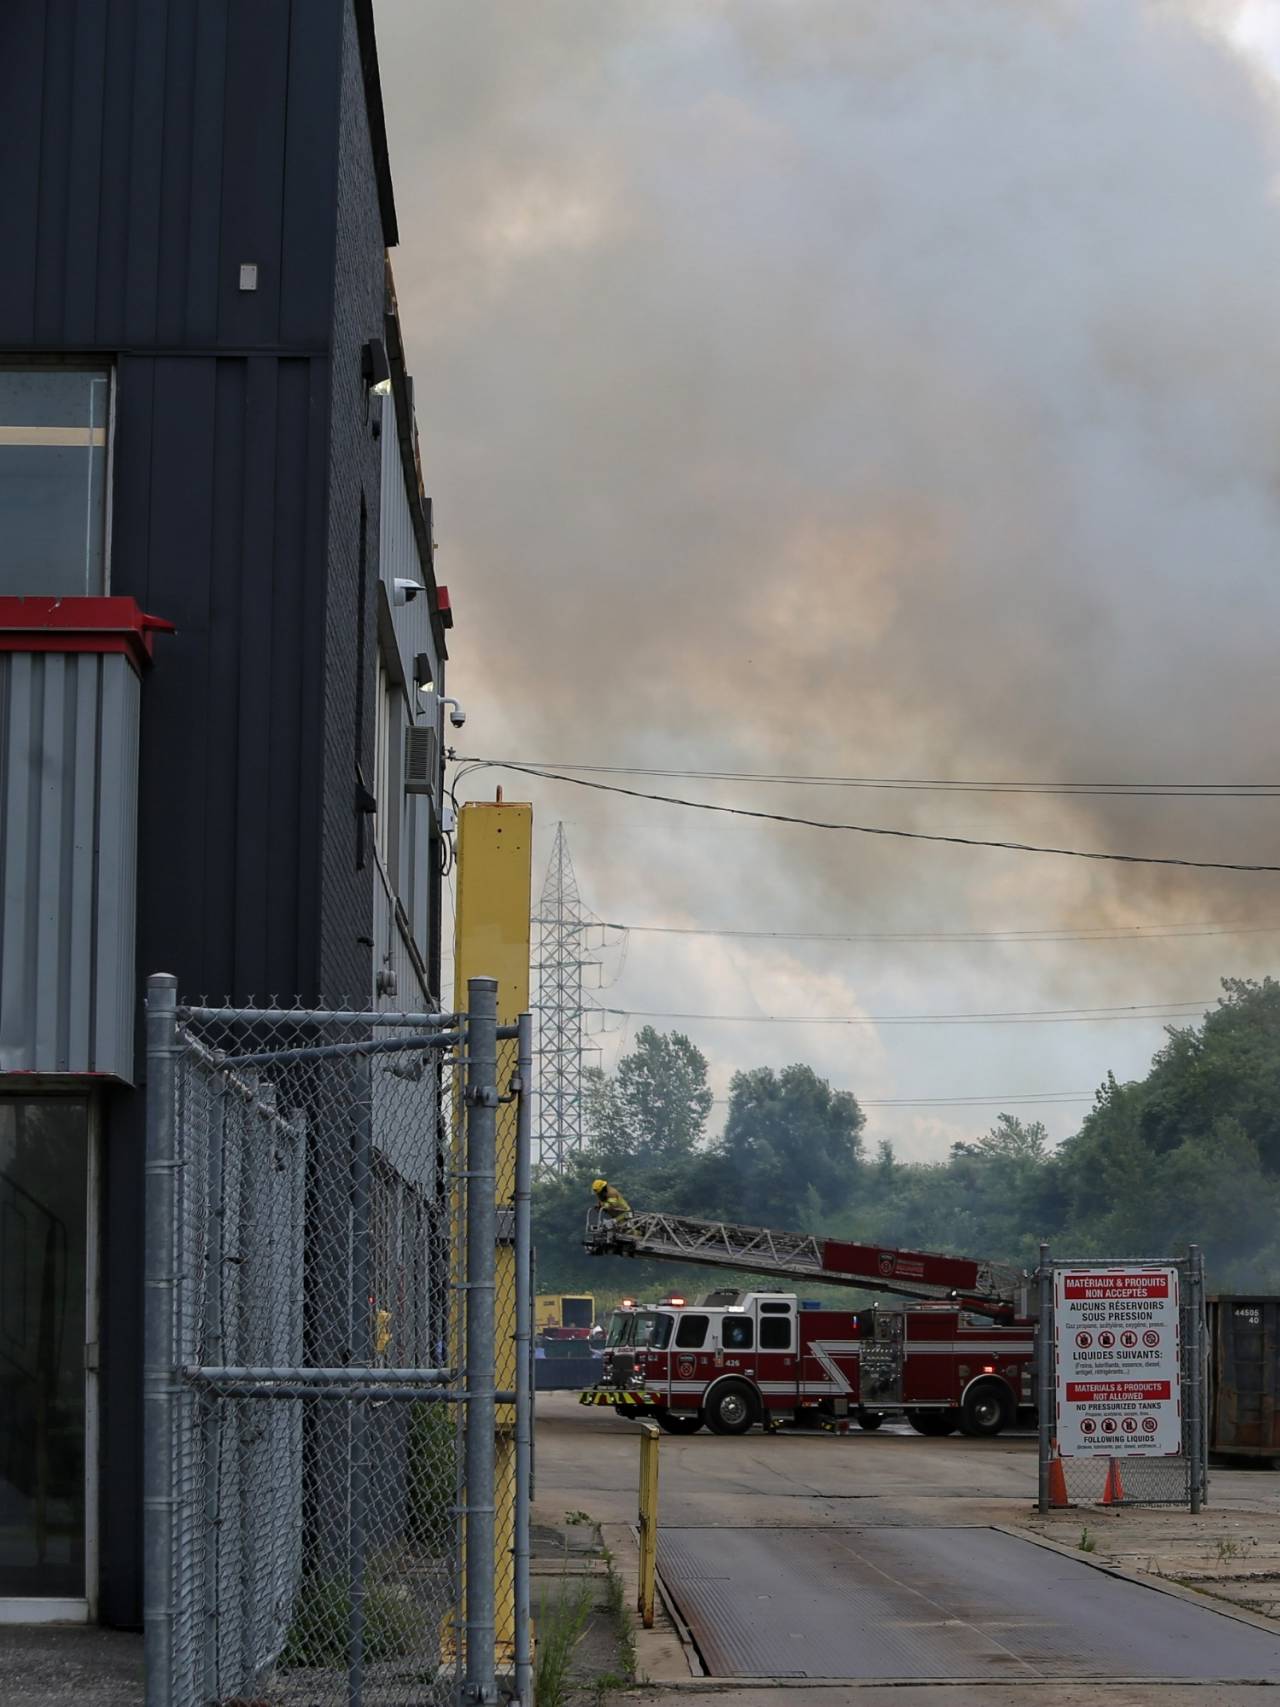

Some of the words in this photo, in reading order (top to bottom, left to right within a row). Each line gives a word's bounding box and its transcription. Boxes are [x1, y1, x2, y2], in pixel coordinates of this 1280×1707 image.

[1066, 1276, 1114, 1288] MATÉRIAUX
[1116, 1278, 1123, 1287] &
[1125, 1278, 1166, 1287] PRODUITS
[1085, 1289, 1104, 1298] NON
[1105, 1287, 1148, 1297] ACCEPTÉS
[1070, 1302, 1106, 1311] AUCUNS
[1108, 1300, 1164, 1311] RÉSERVOIRS
[1082, 1312, 1106, 1321] SOUS
[1108, 1311, 1153, 1321] PRESSION
[1073, 1351, 1114, 1361] LIQUIDES
[1116, 1350, 1163, 1360] SUIVANTS:
[1074, 1384, 1115, 1392] MATERIALS
[1116, 1383, 1122, 1391] &
[1124, 1383, 1162, 1391] PRODUCTS
[1093, 1393, 1108, 1401] NOT
[1109, 1392, 1144, 1400] ALLOWED
[1076, 1403, 1087, 1411] NO
[1088, 1403, 1137, 1411] PRESSURIZED
[1138, 1402, 1162, 1410] TANKS
[1126, 1435, 1155, 1443] LIQUIDS
